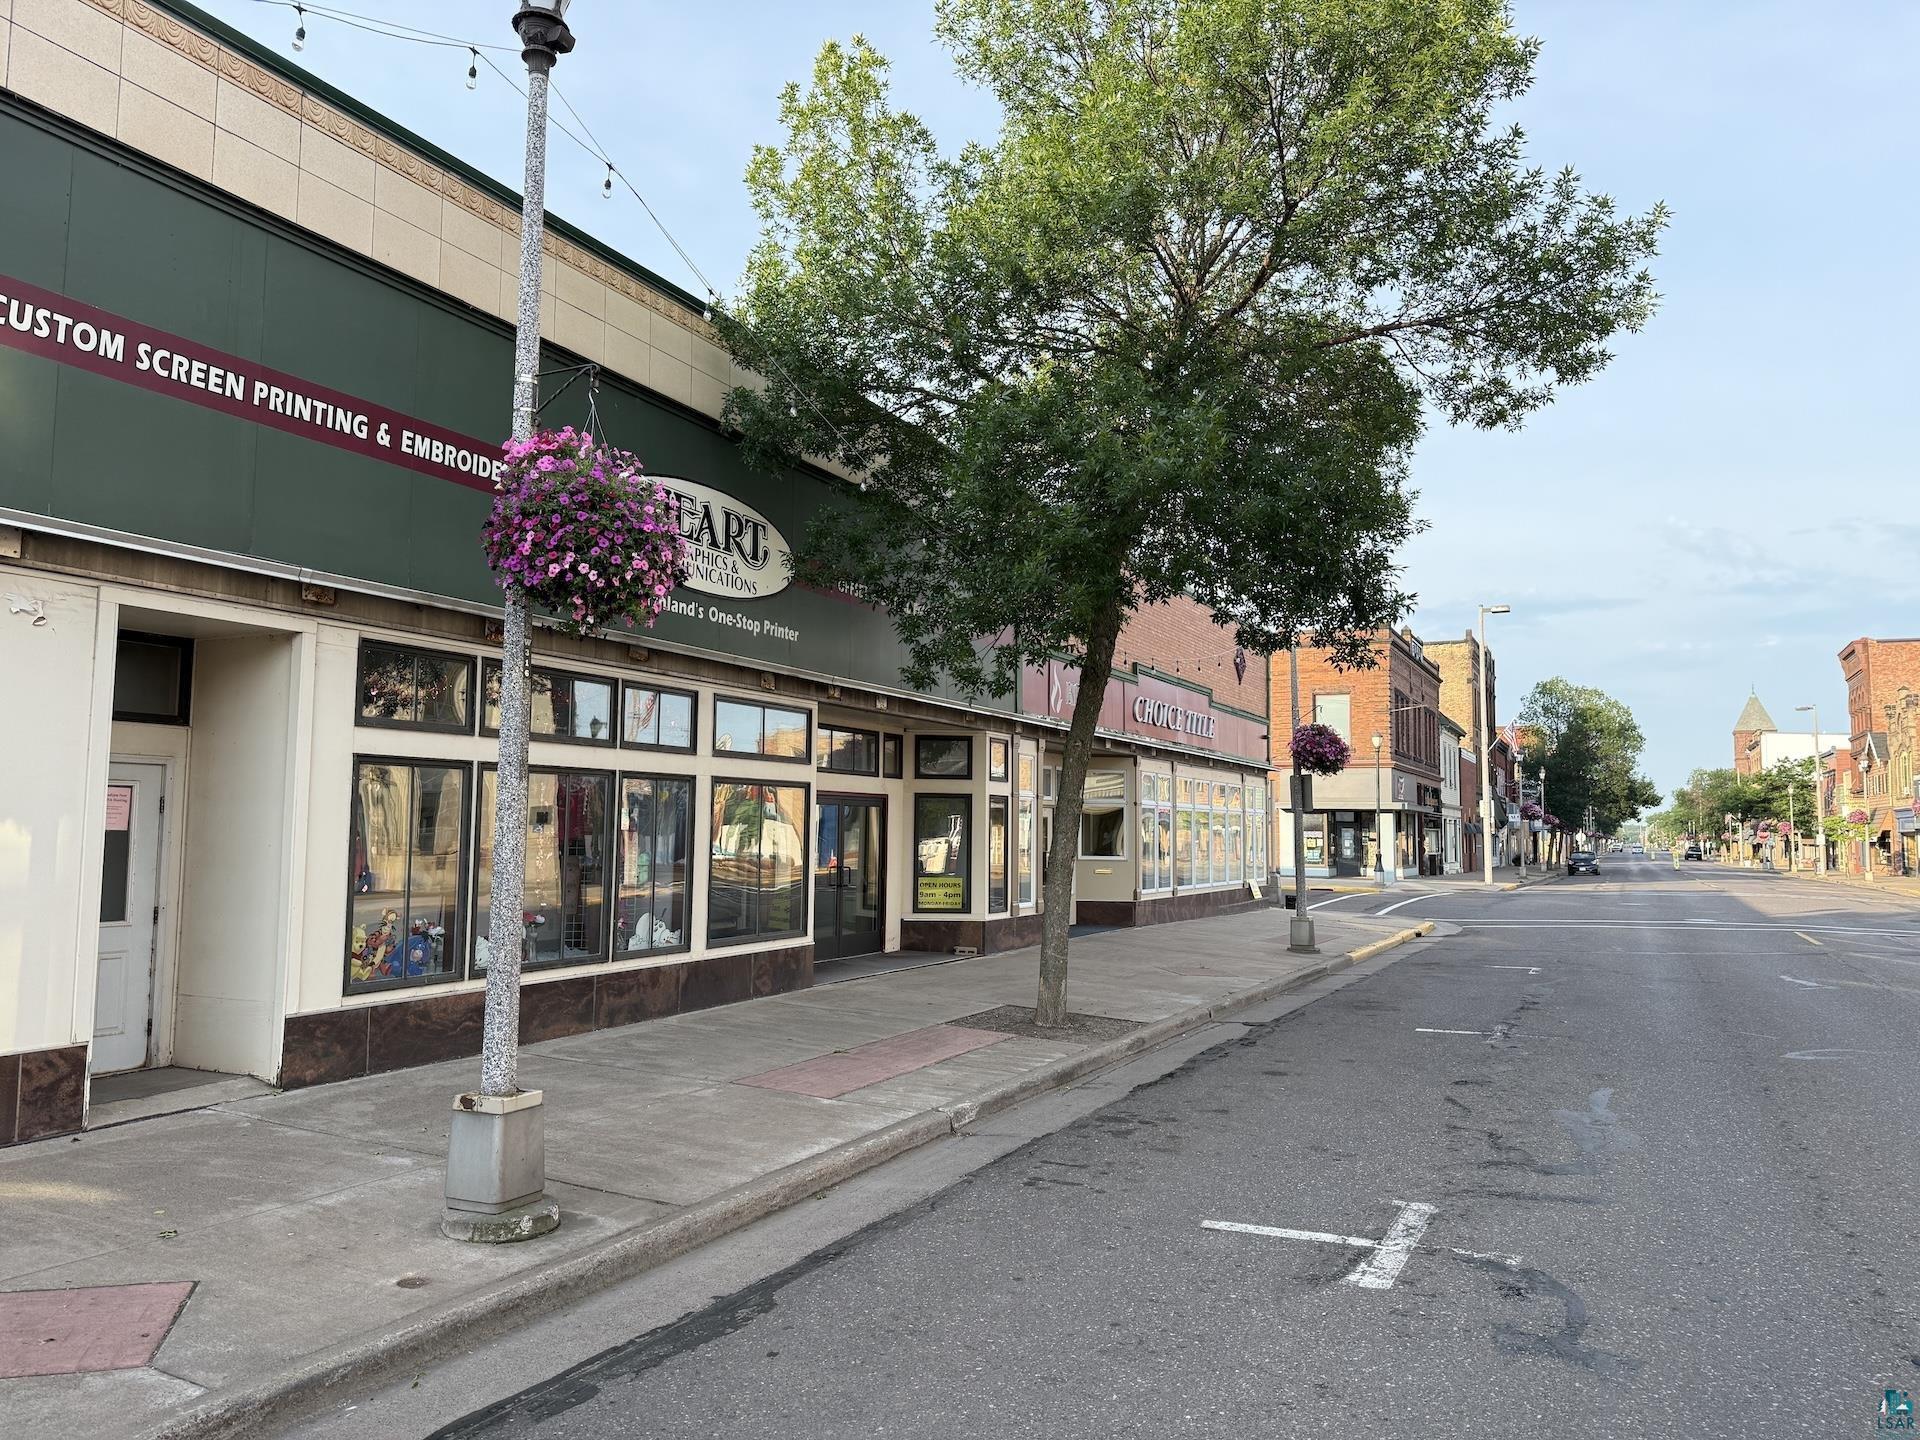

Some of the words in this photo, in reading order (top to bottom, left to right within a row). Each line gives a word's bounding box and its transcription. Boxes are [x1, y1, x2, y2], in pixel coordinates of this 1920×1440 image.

[135, 342, 245, 401] SCREEN
[253, 380, 368, 440] PRINTING
[376, 422, 391, 448] &
[731, 560, 739, 575] &
[708, 606, 761, 637] One-Stop
[763, 620, 799, 642] Printer
[1133, 696, 1183, 731] CHOICE
[1184, 710, 1215, 738] TITLE
[943, 891, 961, 899] 4pm
